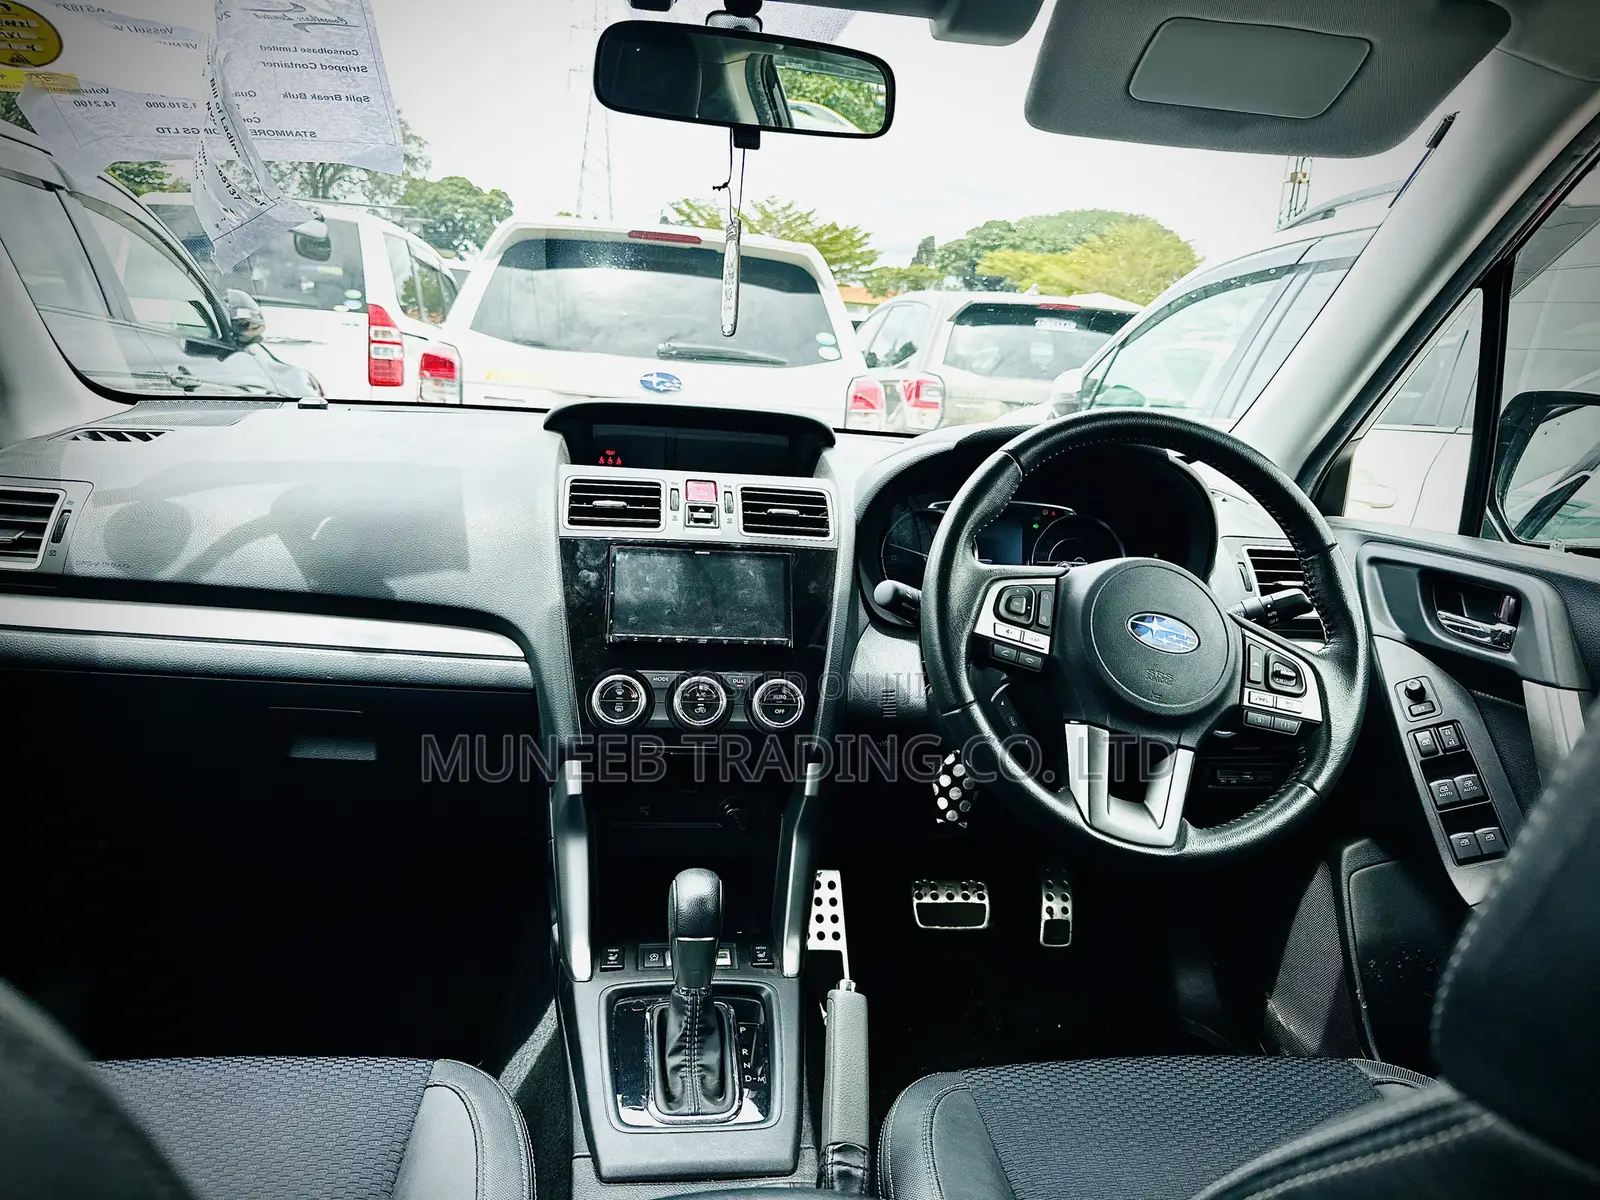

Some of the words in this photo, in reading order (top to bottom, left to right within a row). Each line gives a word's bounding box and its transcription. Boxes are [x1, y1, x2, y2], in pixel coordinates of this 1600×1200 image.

[210, 78, 218, 98] Bill
[1463, 785, 1478, 793] AUTO
[740, 1026, 747, 1034] P
[742, 1048, 749, 1056] R
